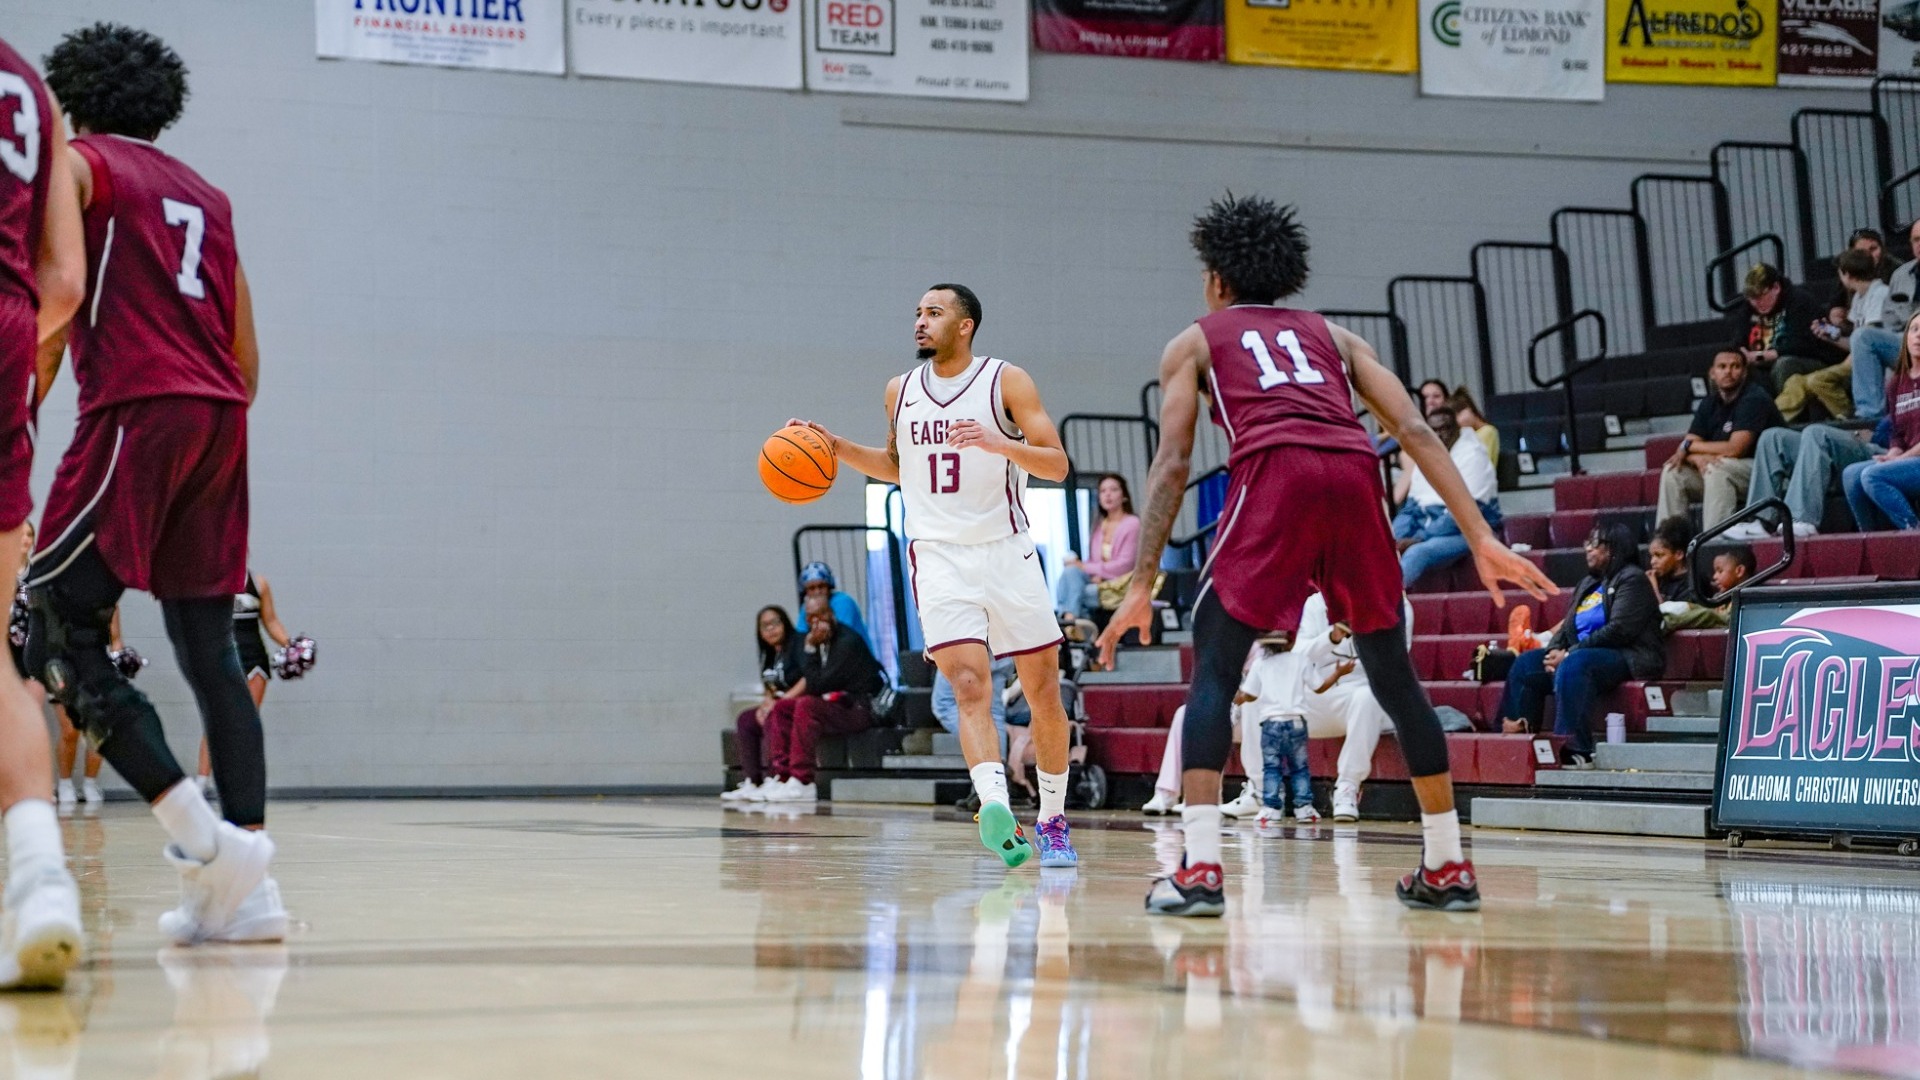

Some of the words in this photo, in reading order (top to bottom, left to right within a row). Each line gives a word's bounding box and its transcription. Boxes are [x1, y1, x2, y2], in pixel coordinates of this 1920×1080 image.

[575, 7, 624, 29] Every
[629, 13, 676, 31] piece
[681, 17, 695, 32] is
[828, 2, 884, 27] RED
[1463, 6, 1540, 24] CITIZENS
[1544, 9, 1587, 28] BANK
[354, 15, 443, 33] FINANCIAL
[448, 22, 527, 42] ADVISORS
[830, 28, 880, 46] TEAM
[1500, 25, 1571, 44] EDMOND
[162, 197, 206, 300] 7
[1240, 329, 1326, 391] 11
[910, 418, 976, 446] EAGL
[928, 452, 961, 494] 13
[1731, 627, 1920, 763] EAGLE
[1728, 774, 1791, 802] OKLAHOMA
[1795, 775, 1860, 804] CHRISTIAN
